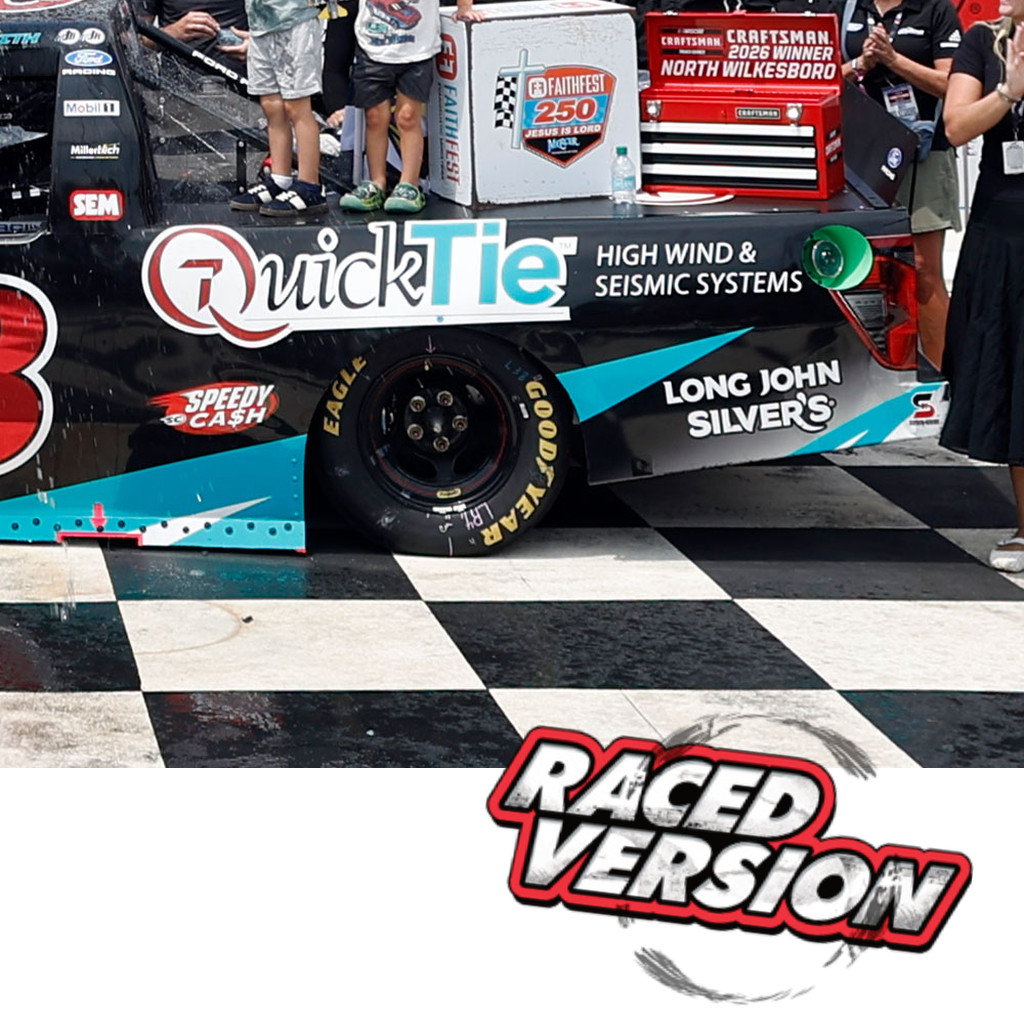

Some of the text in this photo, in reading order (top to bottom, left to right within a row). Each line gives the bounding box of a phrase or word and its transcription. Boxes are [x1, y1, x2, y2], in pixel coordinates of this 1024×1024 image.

[661, 37, 722, 46] CRAFTSMAN
[727, 30, 830, 44] CRAFTSMAN
[728, 45, 833, 61] 2026 WINNER
[192, 50, 238, 81] FORD
[661, 60, 837, 79] NORTH WILKESBORO
[549, 74, 607, 95] FAITHFEST
[66, 102, 115, 114] Mobil 1
[533, 97, 597, 125] 250
[738, 109, 778, 118] CRAFTSMAN
[444, 84, 460, 185] FAITHFEST
[525, 125, 601, 138] JESUS IS LORD
[71, 143, 120, 155] Millertech
[73, 194, 120, 216] SEM
[596, 241, 757, 266] HIGH WIND &
[144, 220, 564, 346] QuickTie
[595, 271, 803, 297] SEISMIC SYSTEMS
[663, 360, 841, 404] LONG JOHN
[181, 385, 274, 413] SPEEDY
[323, 355, 367, 436] EAGLE
[189, 407, 266, 428] CA$H
[687, 393, 833, 437] SILVER'S
[480, 380, 558, 546] GOODYEAR
